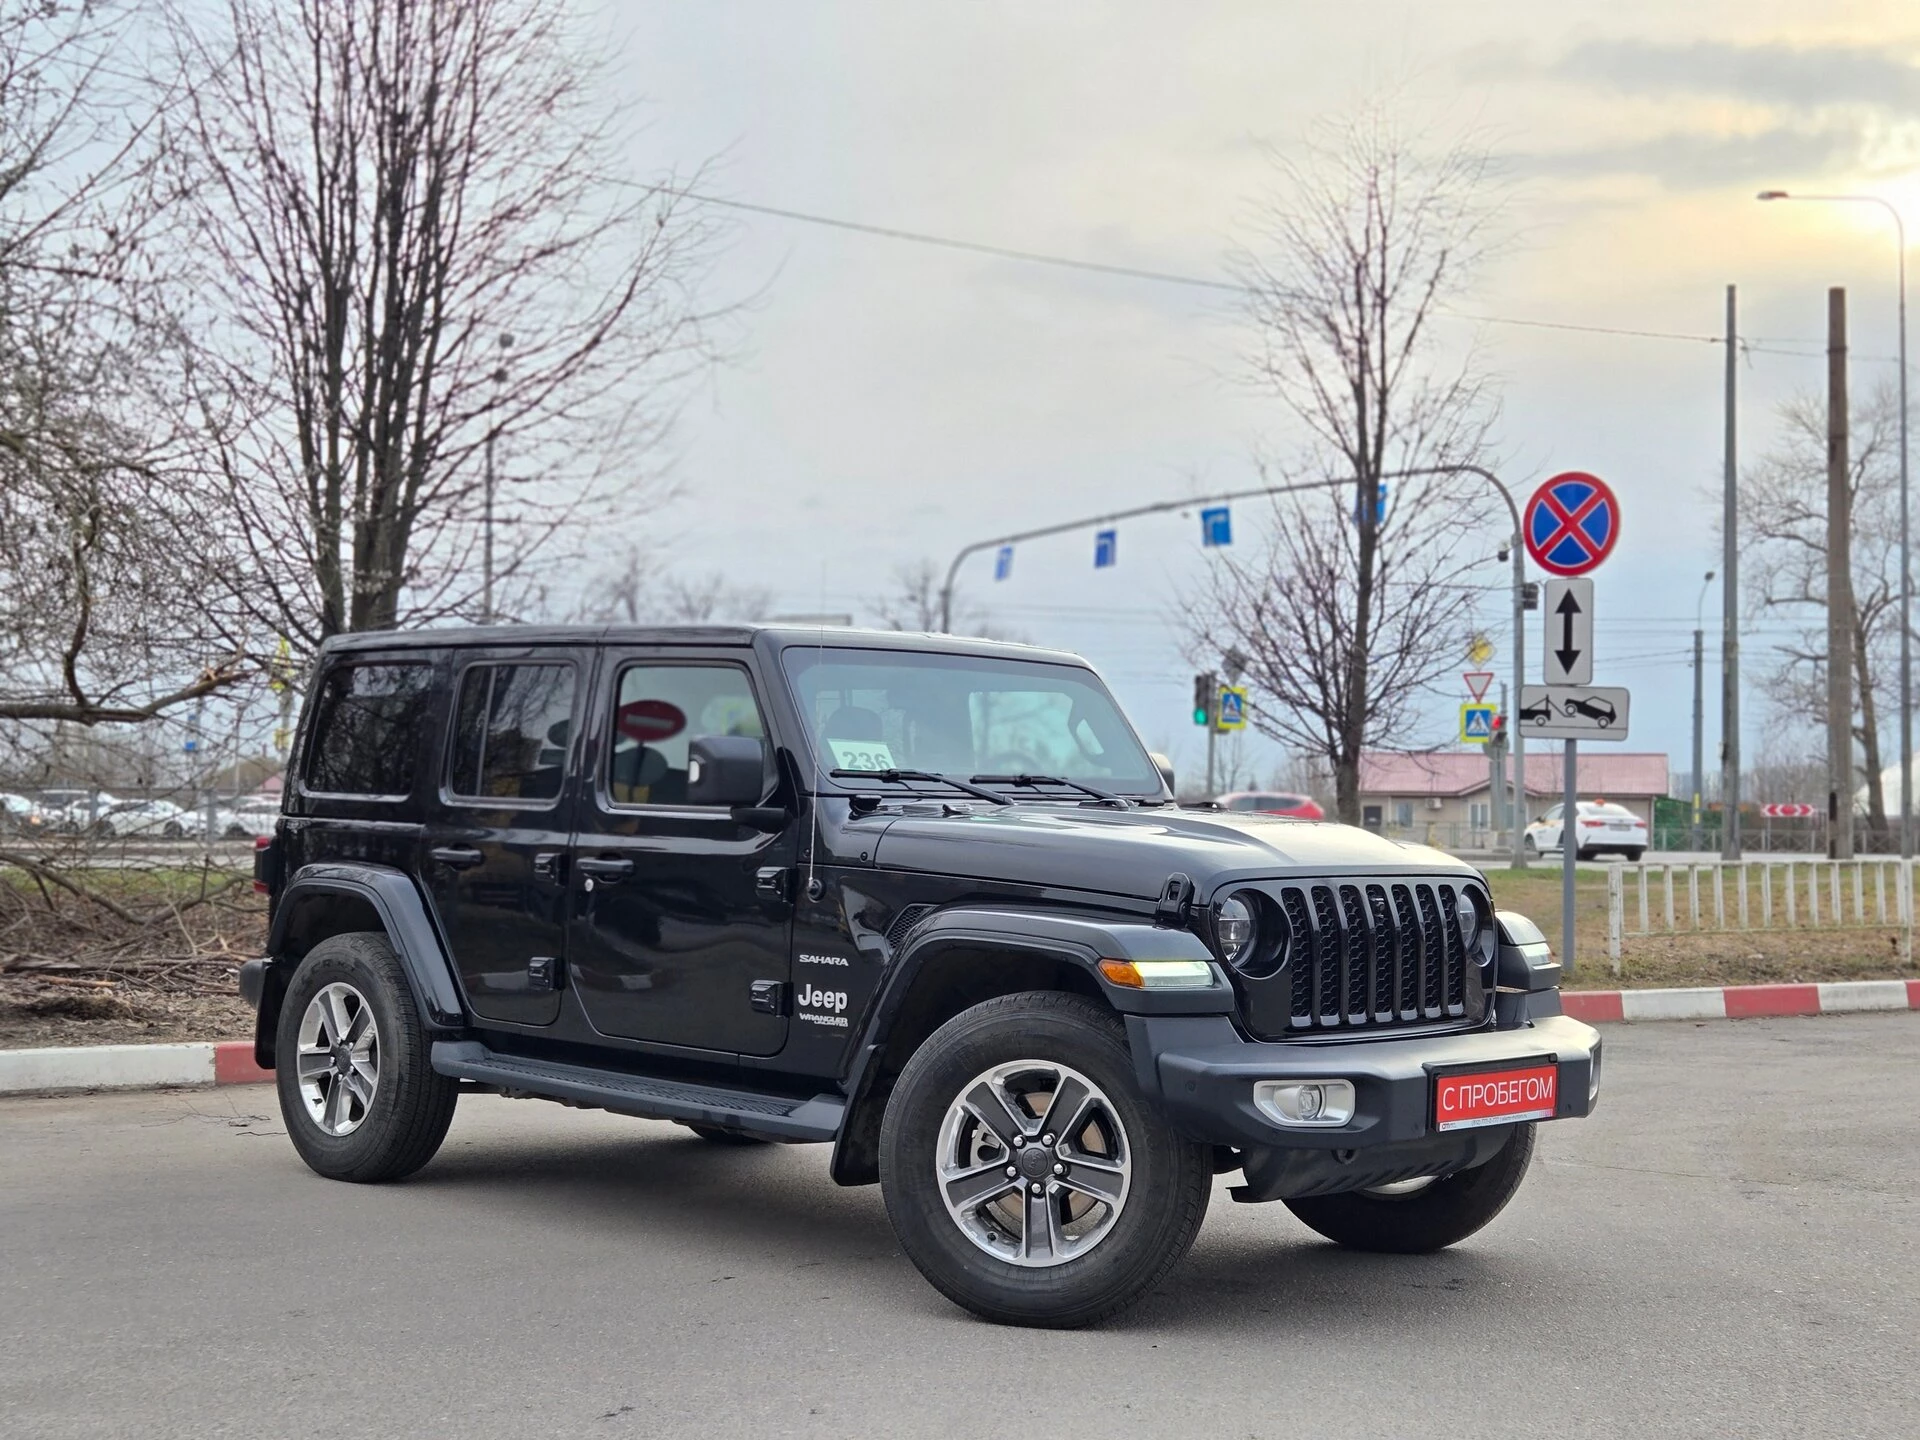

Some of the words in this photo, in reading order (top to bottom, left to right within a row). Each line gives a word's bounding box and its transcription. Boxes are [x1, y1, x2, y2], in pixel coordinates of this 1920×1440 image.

[842, 751, 891, 770] 236
[799, 954, 849, 967] SAHARA
[798, 984, 848, 1013] Jeep
[799, 1012, 848, 1025] WRANGLER
[1442, 1087, 1455, 1111] С
[1459, 1075, 1553, 1109] ПРОБЕГОМ
